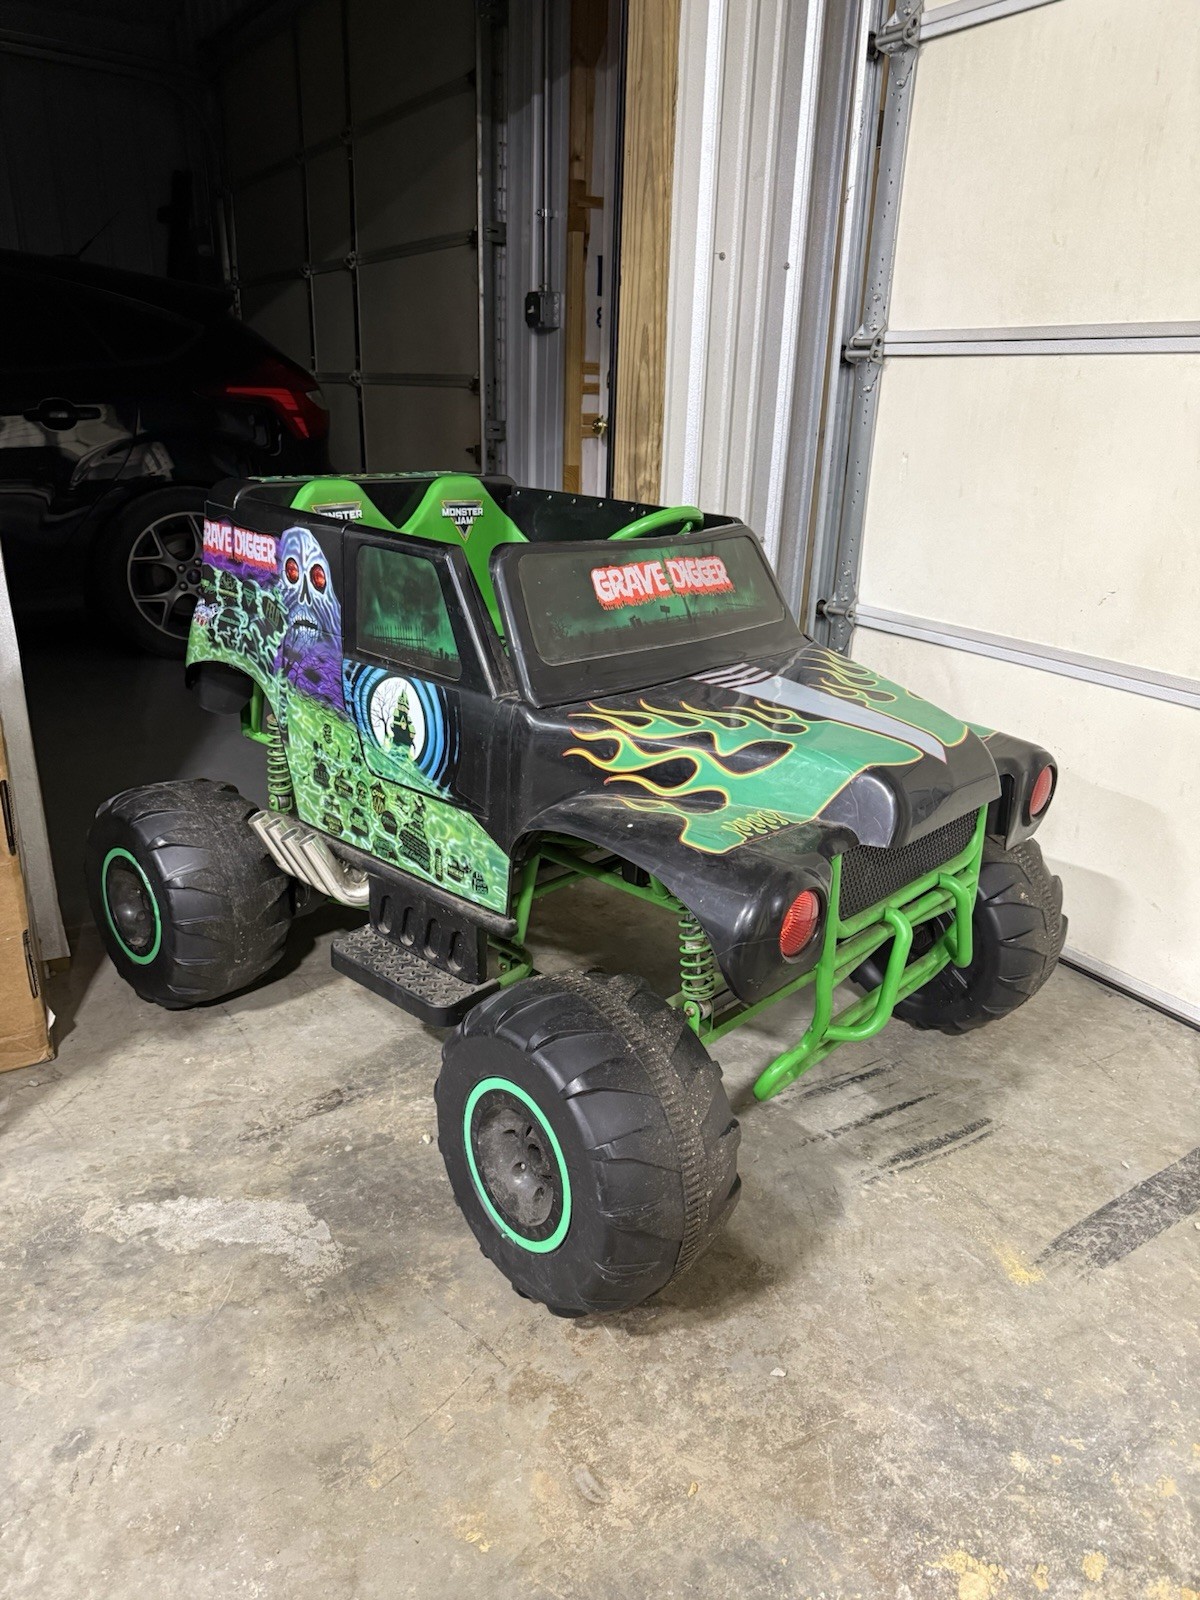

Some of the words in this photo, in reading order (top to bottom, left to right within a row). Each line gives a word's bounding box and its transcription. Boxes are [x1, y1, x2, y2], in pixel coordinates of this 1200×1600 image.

[319, 509, 363, 520] NSTER
[441, 507, 483, 517] MONSTER
[455, 516, 474, 525] JAM
[203, 519, 233, 553] RAVE
[234, 527, 278, 565] DIGGER
[591, 560, 671, 604] GRAVE
[665, 556, 733, 590] DIGGER
